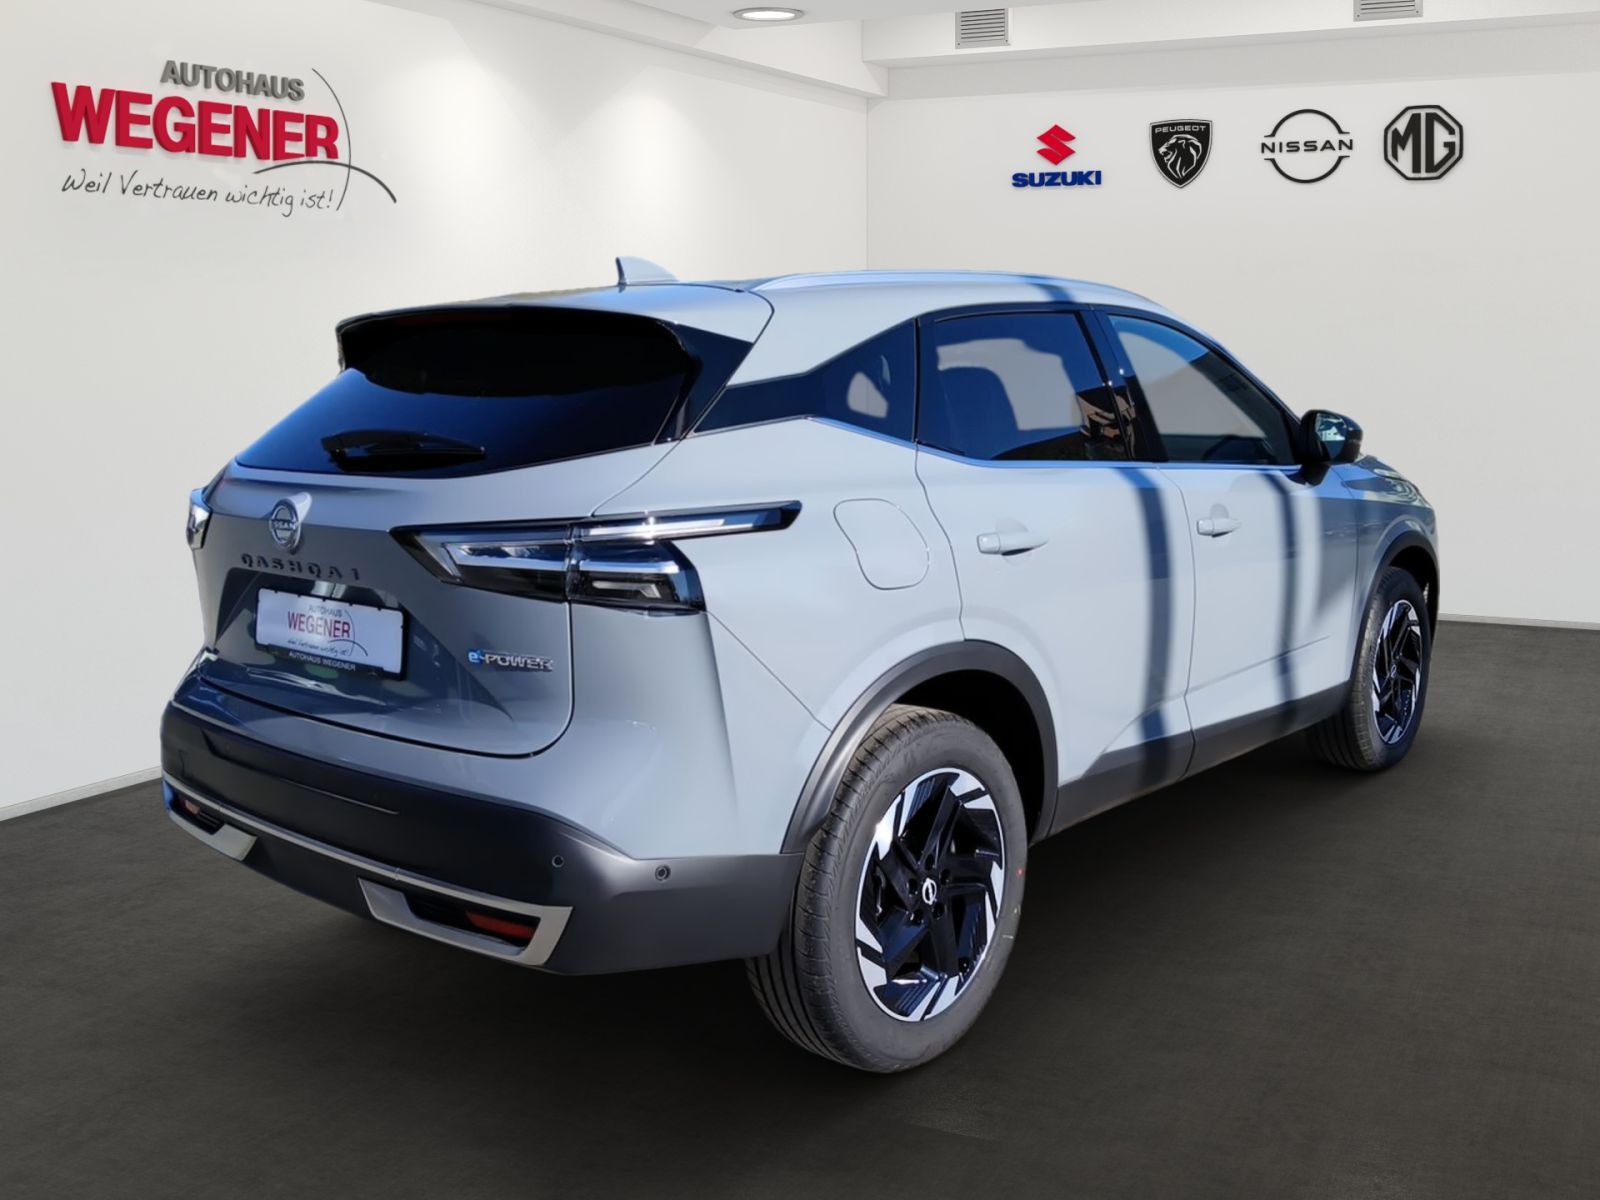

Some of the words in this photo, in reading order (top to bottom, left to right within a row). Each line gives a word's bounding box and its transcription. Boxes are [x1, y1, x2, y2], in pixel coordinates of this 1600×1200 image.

[160, 60, 304, 101] AUTOHAUS
[51, 81, 339, 161] WEGENER
[1154, 125, 1207, 133] PEUGEOT
[1261, 139, 1353, 154] NISSAN
[1391, 112, 1455, 174] MG
[1012, 171, 1102, 187] SUZUKI
[61, 169, 112, 194] Weil
[120, 170, 217, 202] Vertrauen
[225, 185, 294, 217] wichtig
[241, 553, 360, 581] QASHQAI
[288, 611, 351, 638] WEGENER
[289, 651, 321, 664] AUTOHAUS
[322, 658, 356, 671] WEGENER
